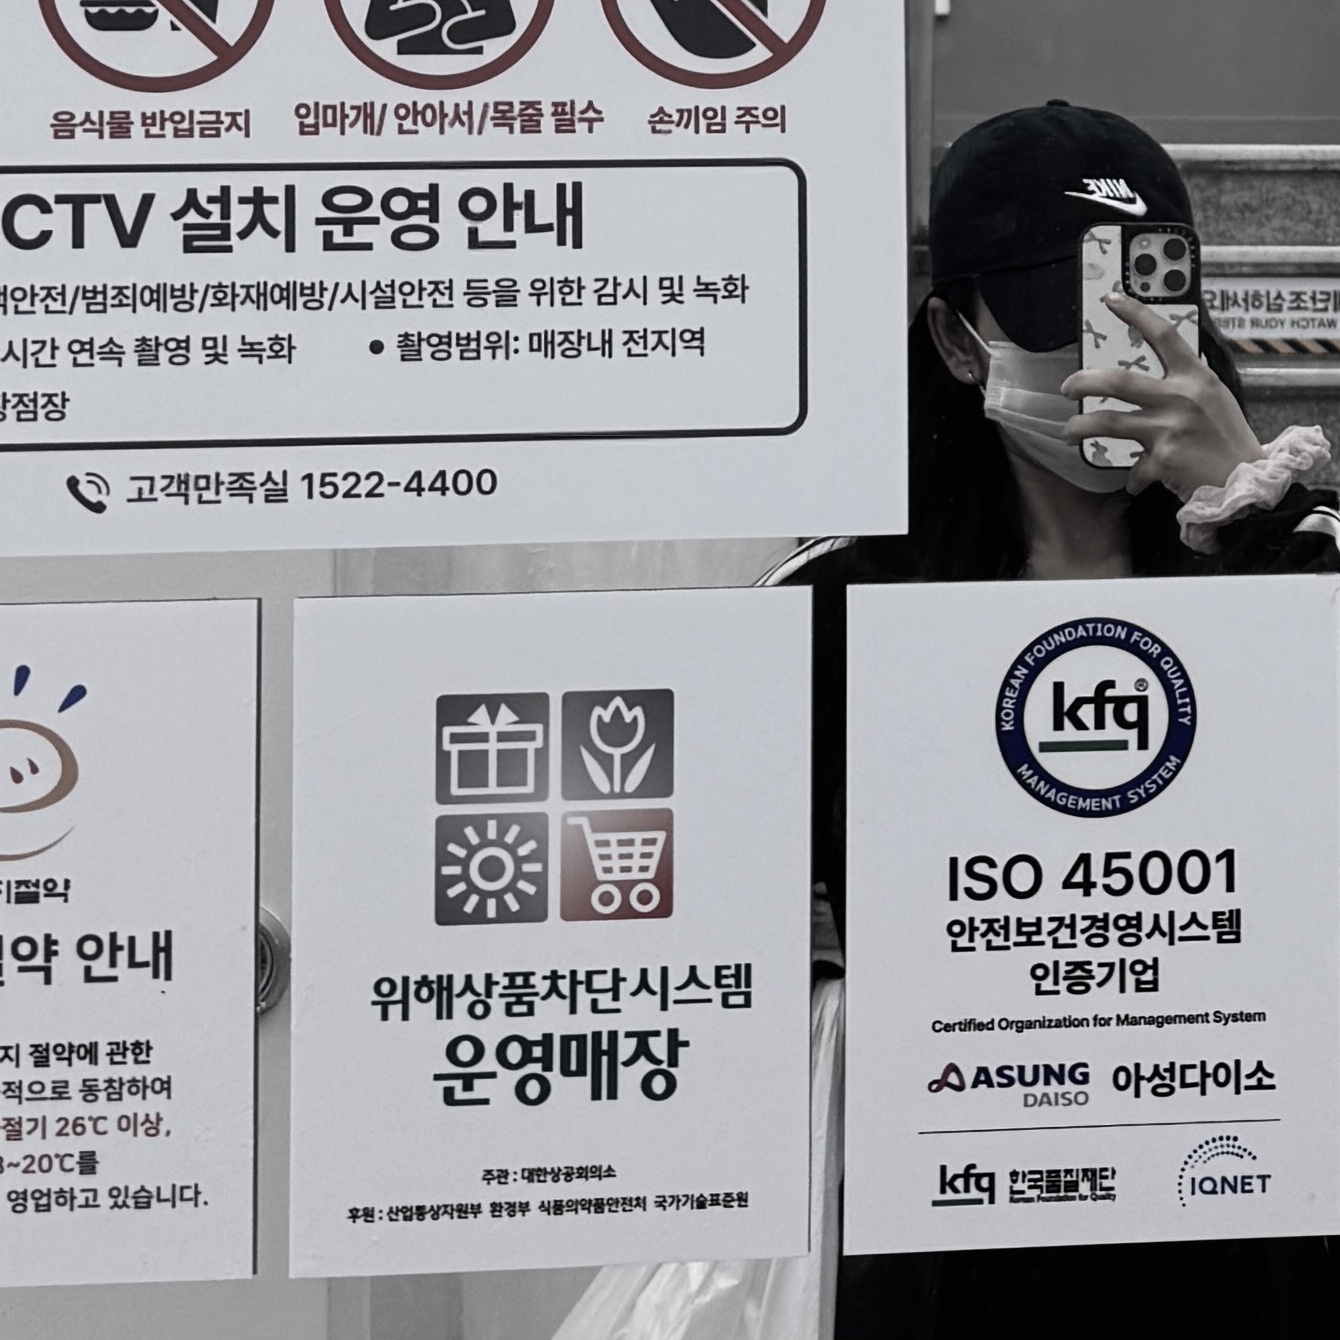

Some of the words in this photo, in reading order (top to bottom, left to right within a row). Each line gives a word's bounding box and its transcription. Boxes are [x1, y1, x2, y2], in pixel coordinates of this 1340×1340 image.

[49, 109, 135, 140] 음식물
[140, 108, 251, 139] 반입금지
[294, 100, 388, 137] 입마개/
[550, 99, 605, 134] 필수
[647, 104, 727, 135] 손끼임
[733, 104, 786, 135] 주의
[1, 192, 156, 251] CTV
[169, 184, 296, 254] 설치
[314, 182, 440, 252] 운영
[457, 180, 583, 251] 안내
[462, 277, 521, 309] 등을
[527, 275, 587, 308] 위한
[592, 274, 648, 307] 감시
[658, 274, 685, 305] 및
[692, 273, 750, 305] 녹화
[0, 336, 60, 370] 시간
[67, 336, 126, 368] 연속
[133, 334, 191, 367] 촬영
[201, 334, 229, 366] 및
[236, 333, 297, 365] 녹화
[396, 329, 520, 363] 촬영범위:
[528, 328, 613, 360] 매장내
[622, 326, 705, 358] 전지역
[126, 469, 289, 506] 고객만족실
[300, 468, 498, 500] 1522-4400
[1000, 665, 1029, 731] KOREAN
[1025, 623, 1128, 666] FOUNDATION
[1130, 631, 1162, 658] FOR
[1160, 657, 1192, 726] QUALITY
[1052, 679, 1149, 751] kfq
[1016, 763, 1122, 811] MANAGEMENT
[1127, 754, 1182, 803] SYSTEM
[948, 853, 1044, 902] ISO
[1061, 848, 1236, 898] 45001
[946, 908, 1242, 953] 안전보건경영시스템
[0, 932, 60, 987] 약
[75, 929, 173, 984] 안내
[1029, 956, 1160, 997] 인증기업
[370, 962, 752, 1022] 위해상품차단시스템
[931, 1017, 995, 1034] Certified
[997, 1014, 1090, 1034] Organization
[1092, 1013, 1114, 1028] for
[1115, 1011, 1211, 1029] Management
[1212, 1010, 1267, 1027] System
[28, 1040, 99, 1069] 절약에
[105, 1039, 154, 1066] 관한
[432, 1027, 691, 1107] 운영매장
[1, 1079, 73, 1106] 적으로
[78, 1074, 172, 1104] 동참하여
[970, 1061, 1090, 1089] ASUNG
[1112, 1058, 1277, 1099] 아성다이소
[1023, 1090, 1090, 1108] DAISO
[0, 1115, 47, 1142] 절기
[116, 1111, 172, 1138] 이상,
[520, 1164, 617, 1184] 대한상공회의소
[938, 1161, 997, 1205] kfq
[1190, 1174, 1272, 1196] IQNET
[6, 1186, 101, 1214] 영업하고
[107, 1182, 209, 1211] 있습니다.
